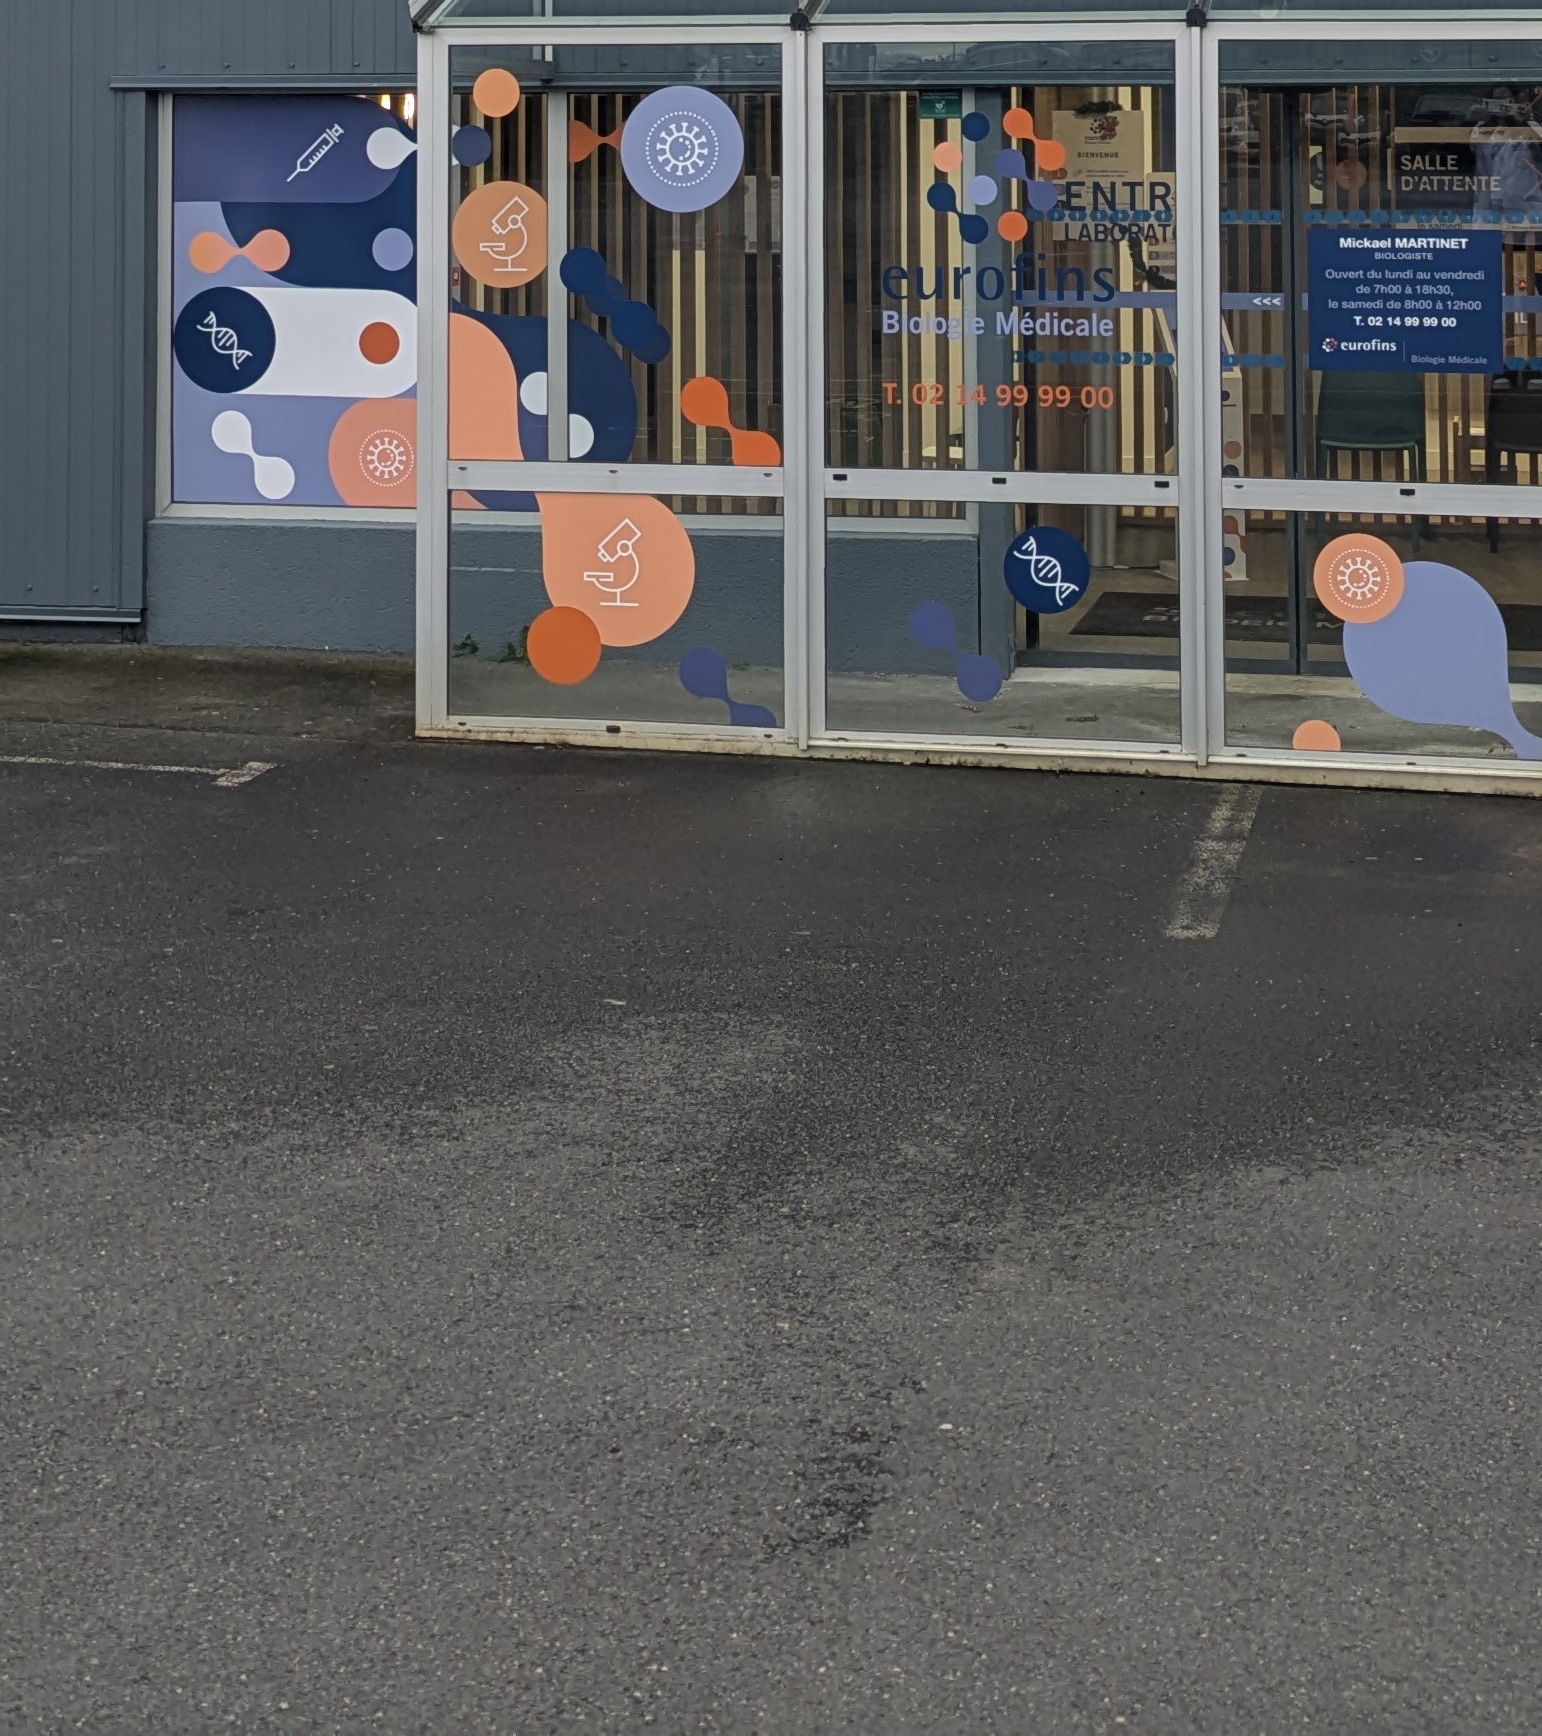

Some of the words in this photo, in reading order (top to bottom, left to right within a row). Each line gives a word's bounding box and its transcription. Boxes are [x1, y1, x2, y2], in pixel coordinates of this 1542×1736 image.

[1400, 154, 1459, 171] SALLE
[1400, 175, 1501, 192] D'ATTENTE
[1065, 180, 1172, 212] ENTR
[1064, 223, 1177, 243] LABORAT
[1339, 237, 1391, 249] Mickael
[1395, 238, 1469, 249] MARTINET
[1374, 252, 1434, 260] BIOLOGISTE
[882, 251, 1116, 302] eurofins
[1325, 268, 1364, 279] Ouvert
[1367, 269, 1382, 279] du
[1385, 269, 1413, 279] lundi
[1416, 271, 1431, 279] au
[1434, 270, 1485, 280] vendredi
[1355, 284, 1371, 294] de
[1374, 284, 1402, 295] 7h00
[1404, 284, 1412, 295] à
[1415, 284, 1454, 296] 18h30,
[1328, 299, 1339, 309] le
[1341, 299, 1384, 309] samedi
[1386, 299, 1401, 309] de
[1404, 299, 1432, 310] 8h00
[1435, 299, 1443, 310] à
[1446, 300, 1482, 311] 12h00
[882, 310, 985, 340] Biologie
[996, 311, 1115, 337] Médicale
[1353, 316, 1364, 326] T.
[1367, 316, 1383, 326] 02
[1386, 316, 1401, 327] 14
[1404, 316, 1420, 327] 99
[1423, 317, 1438, 327] 99
[1441, 317, 1457, 327] 00
[1340, 338, 1397, 352] eurofins
[1411, 354, 1446, 365] Biologie
[1448, 355, 1488, 365] Médicale
[882, 381, 902, 405] T.
[912, 382, 944, 406] 02
[956, 383, 987, 406] 14
[995, 384, 1029, 408] 99
[1038, 385, 1071, 408] 99
[1080, 386, 1115, 409] 00
